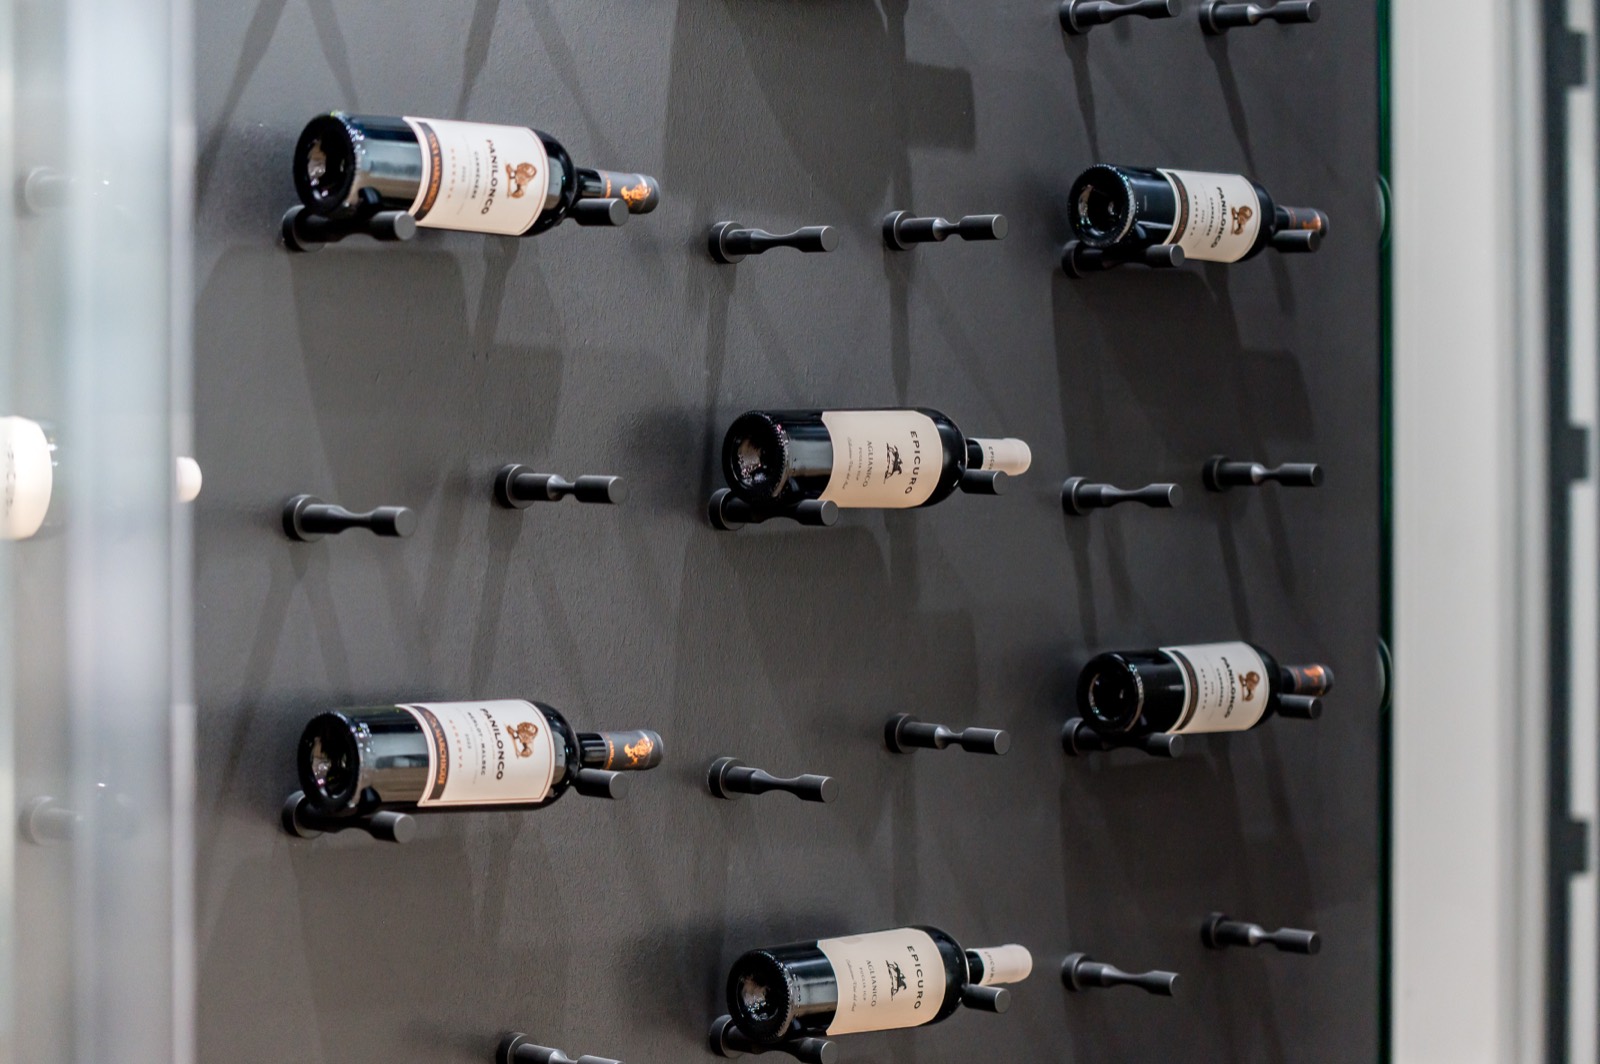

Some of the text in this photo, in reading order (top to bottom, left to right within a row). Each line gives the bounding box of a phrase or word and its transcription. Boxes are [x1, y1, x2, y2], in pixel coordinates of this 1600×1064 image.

[481, 139, 499, 215] PANILONCO
[862, 440, 874, 488] AGLIANICO
[904, 430, 921, 495] EPICURO
[480, 708, 505, 780] PANILONCO
[866, 960, 878, 1007] AGLIANICO
[907, 945, 924, 1010] EPICURO
